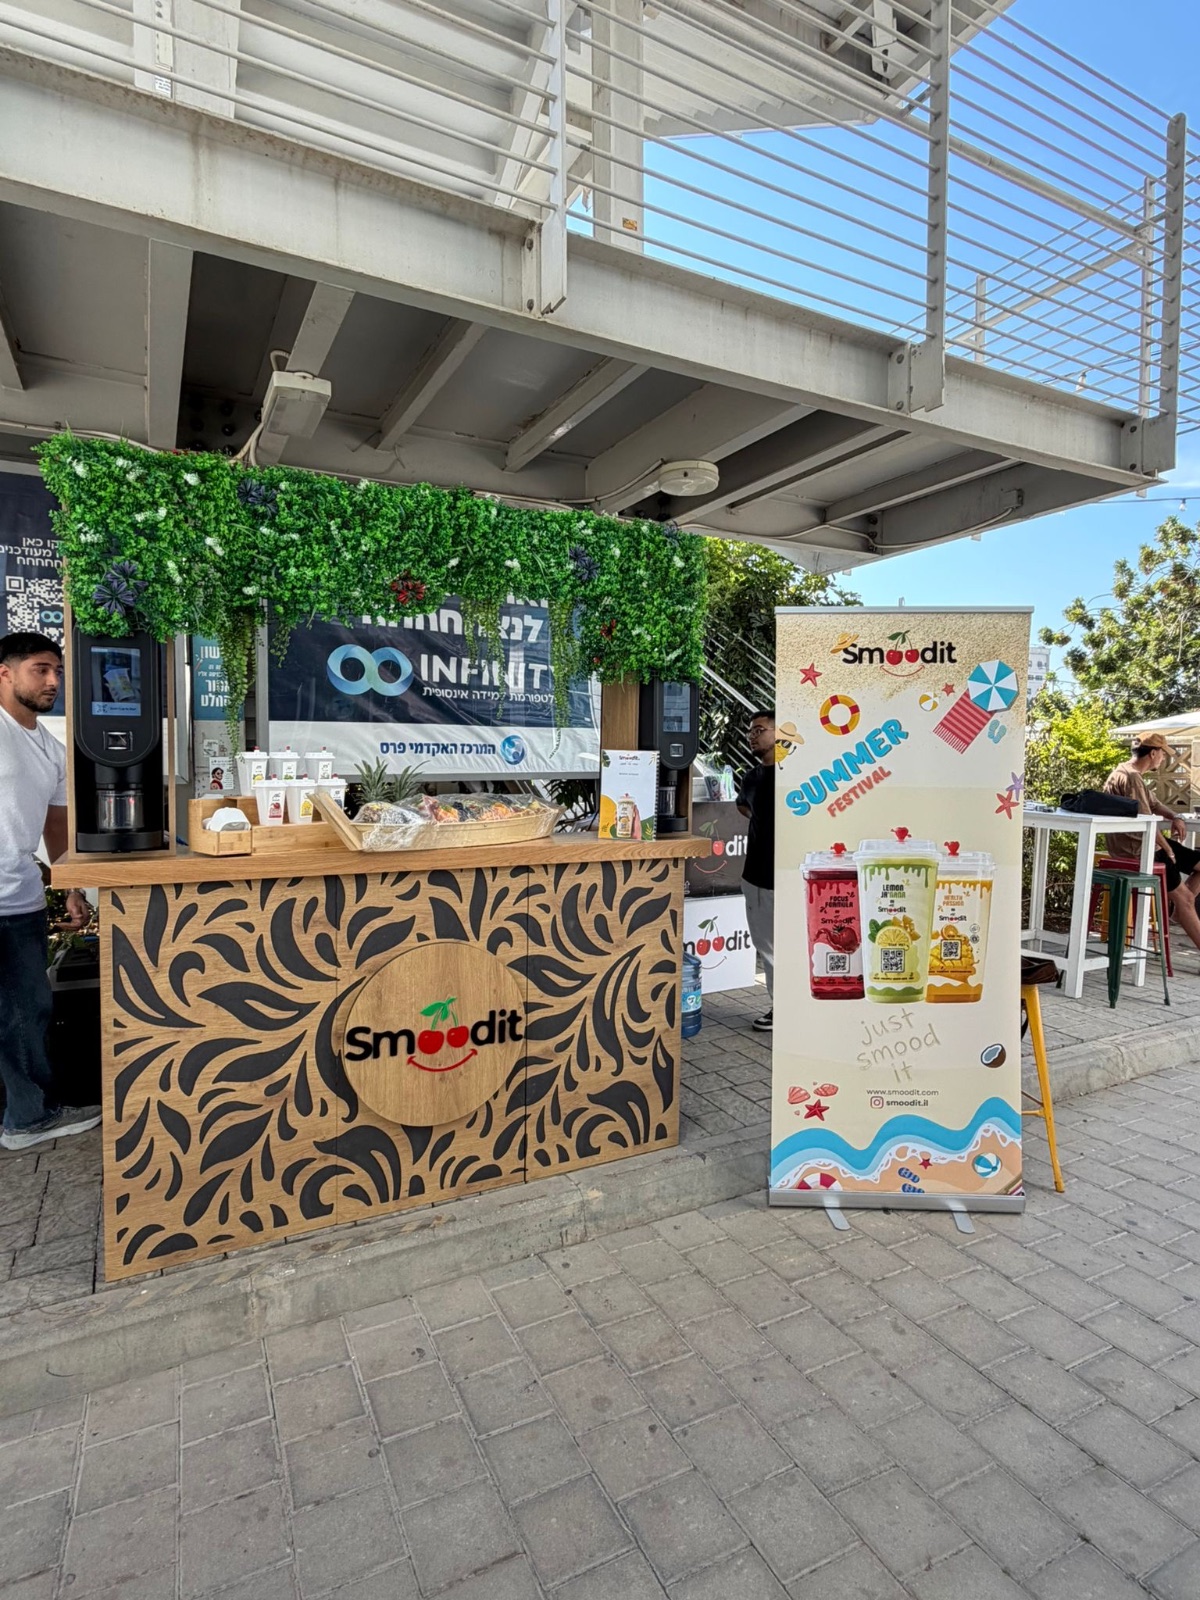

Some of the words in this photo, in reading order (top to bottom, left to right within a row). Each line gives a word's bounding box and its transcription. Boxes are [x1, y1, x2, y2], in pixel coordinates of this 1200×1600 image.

[22, 537, 44, 547] כאן
[842, 640, 958, 665] Smoodit
[420, 653, 557, 690] INFINIT
[422, 687, 469, 699] אינסופית
[380, 742, 406, 755] פרס
[408, 742, 458, 757] האקדמי
[460, 743, 496, 755] המרכז
[785, 718, 909, 817] SUMMER
[826, 765, 892, 818] FESTIVAL
[345, 1008, 523, 1062] Smoodit
[860, 1007, 915, 1047] just
[856, 1023, 941, 1071] smood
[891, 1060, 913, 1084] it
[867, 1087, 939, 1096] www.smoodit.com
[886, 1098, 929, 1107] smoodit.il
